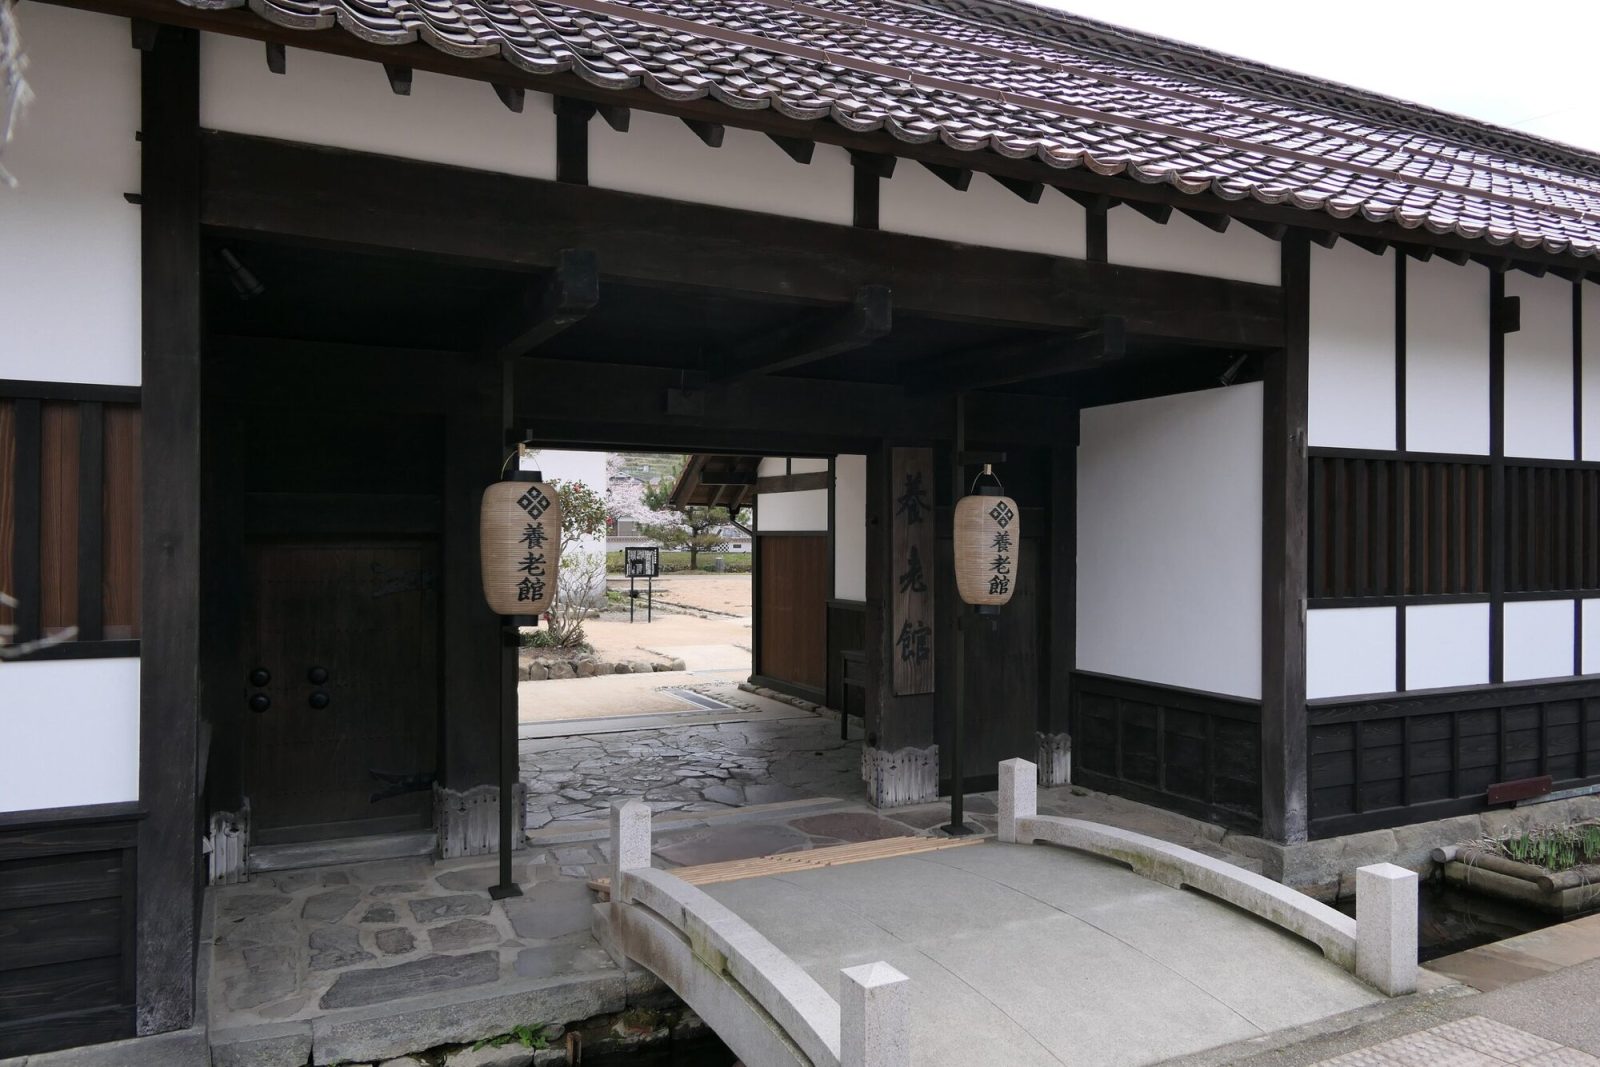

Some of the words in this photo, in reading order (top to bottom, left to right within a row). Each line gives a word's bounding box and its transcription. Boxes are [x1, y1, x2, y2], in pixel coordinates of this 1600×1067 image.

[517, 523, 547, 602] 養老館
[897, 472, 932, 664] 養老館
[988, 531, 1012, 595] 養老館
